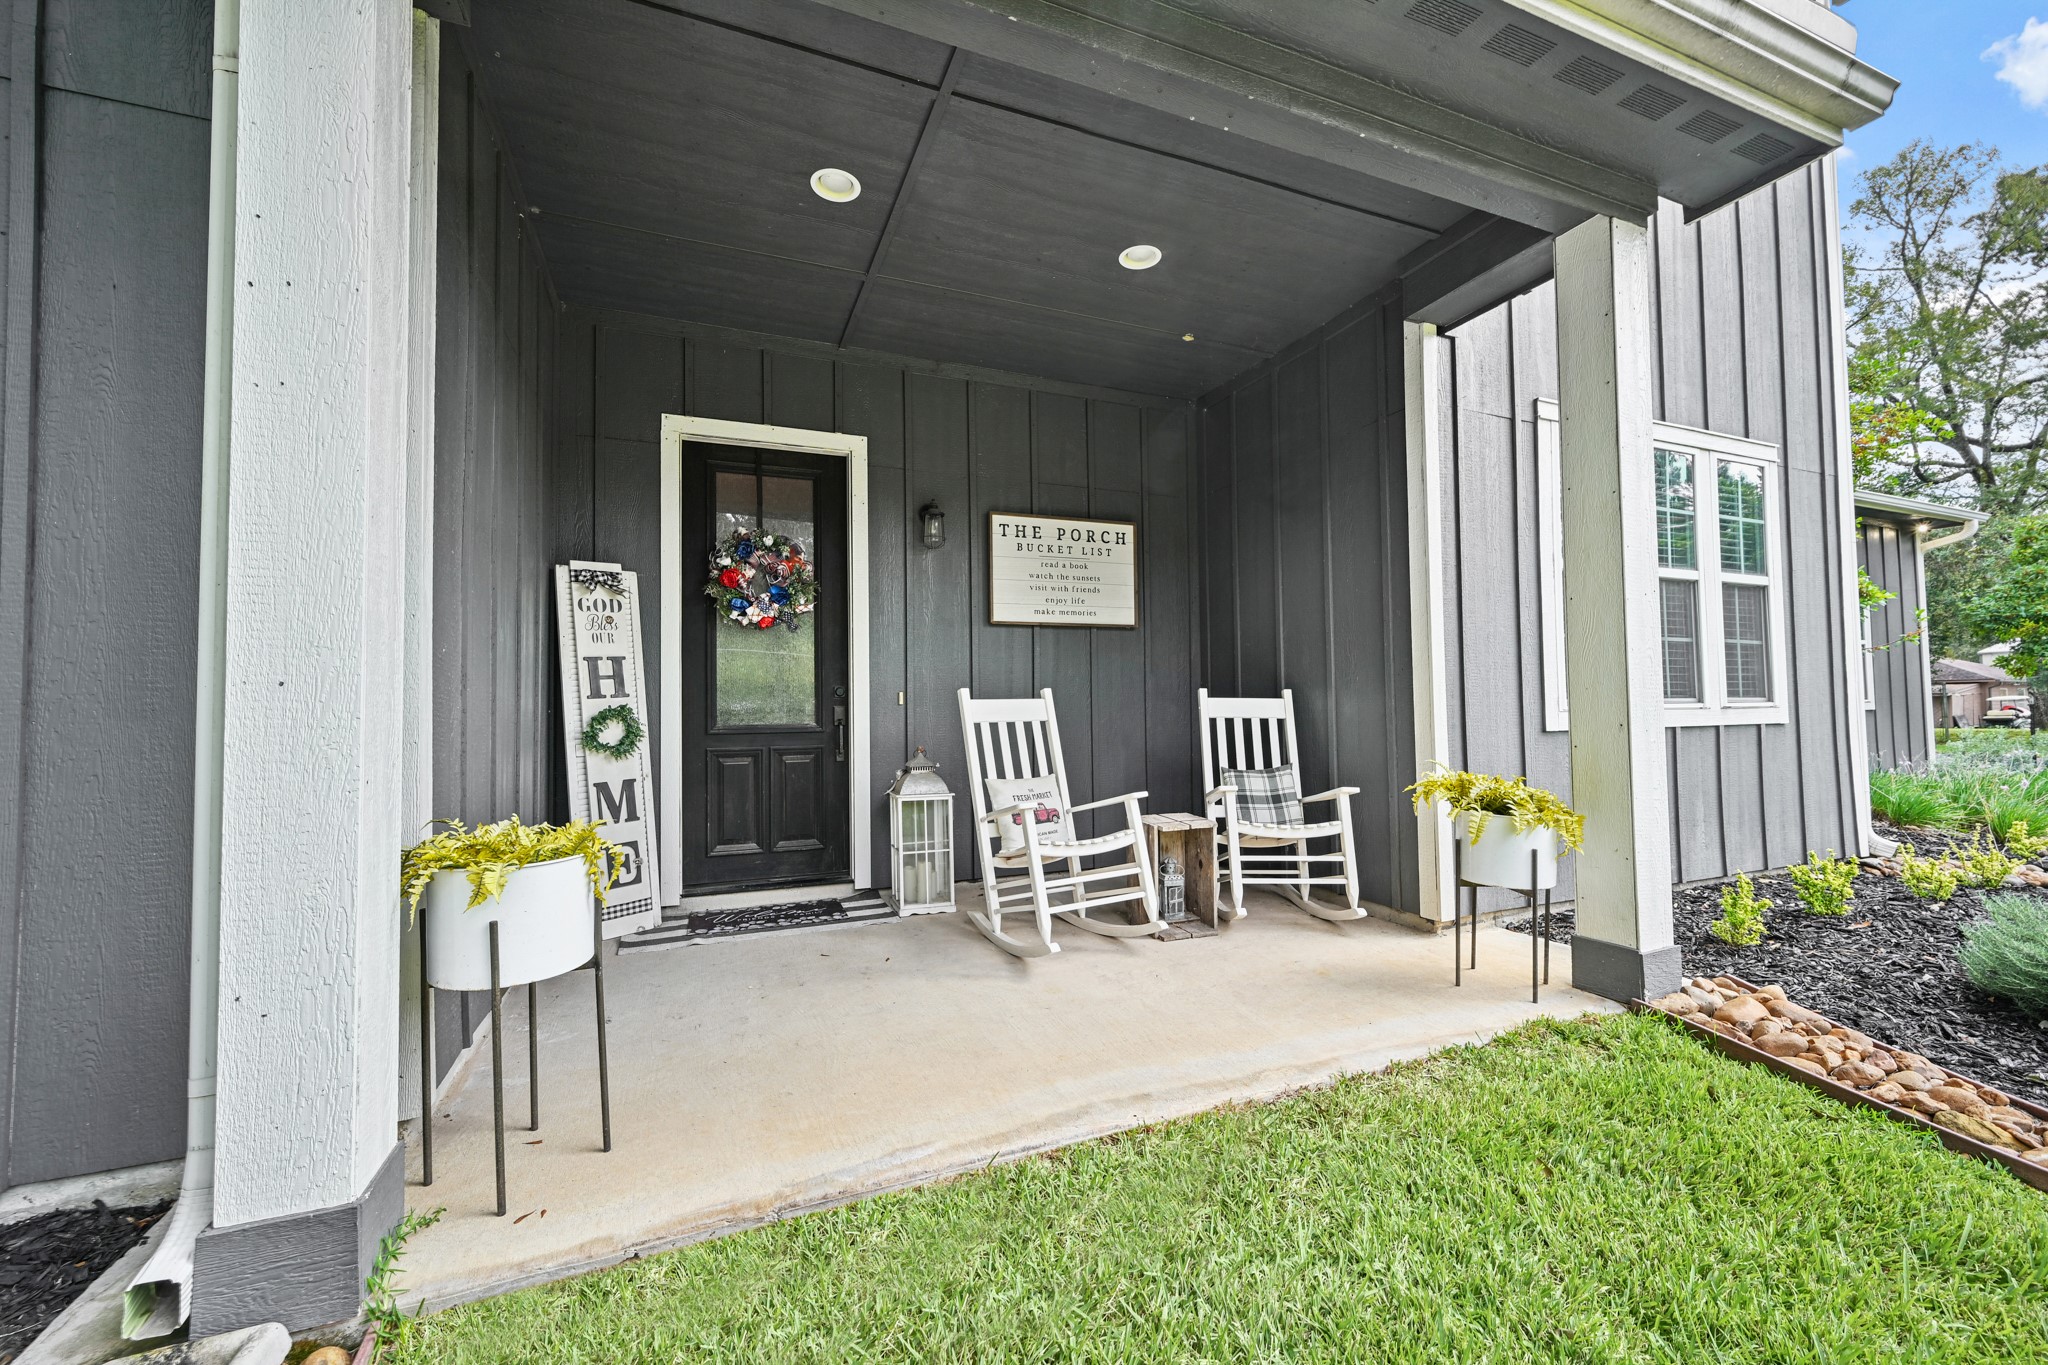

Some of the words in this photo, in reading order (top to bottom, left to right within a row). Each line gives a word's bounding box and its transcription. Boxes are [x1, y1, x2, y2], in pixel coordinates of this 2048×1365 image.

[999, 523, 1042, 540] THE
[1057, 528, 1127, 545] PORCH
[1017, 543, 1074, 555] BUCKET
[1082, 547, 1112, 557] LIST
[1069, 562, 1089, 570] book
[1028, 572, 1054, 580] watch
[1056, 573, 1070, 581] the
[1029, 584, 1048, 592] visit
[1050, 585, 1069, 593] with
[1071, 586, 1101, 594] friends
[577, 597, 623, 614] GOD
[1045, 597, 1068, 606] enjoy
[1071, 597, 1086, 605] life
[584, 613, 619, 631] Bless
[591, 632, 615, 644] OUR
[1032, 792, 1053, 800] MARKET
